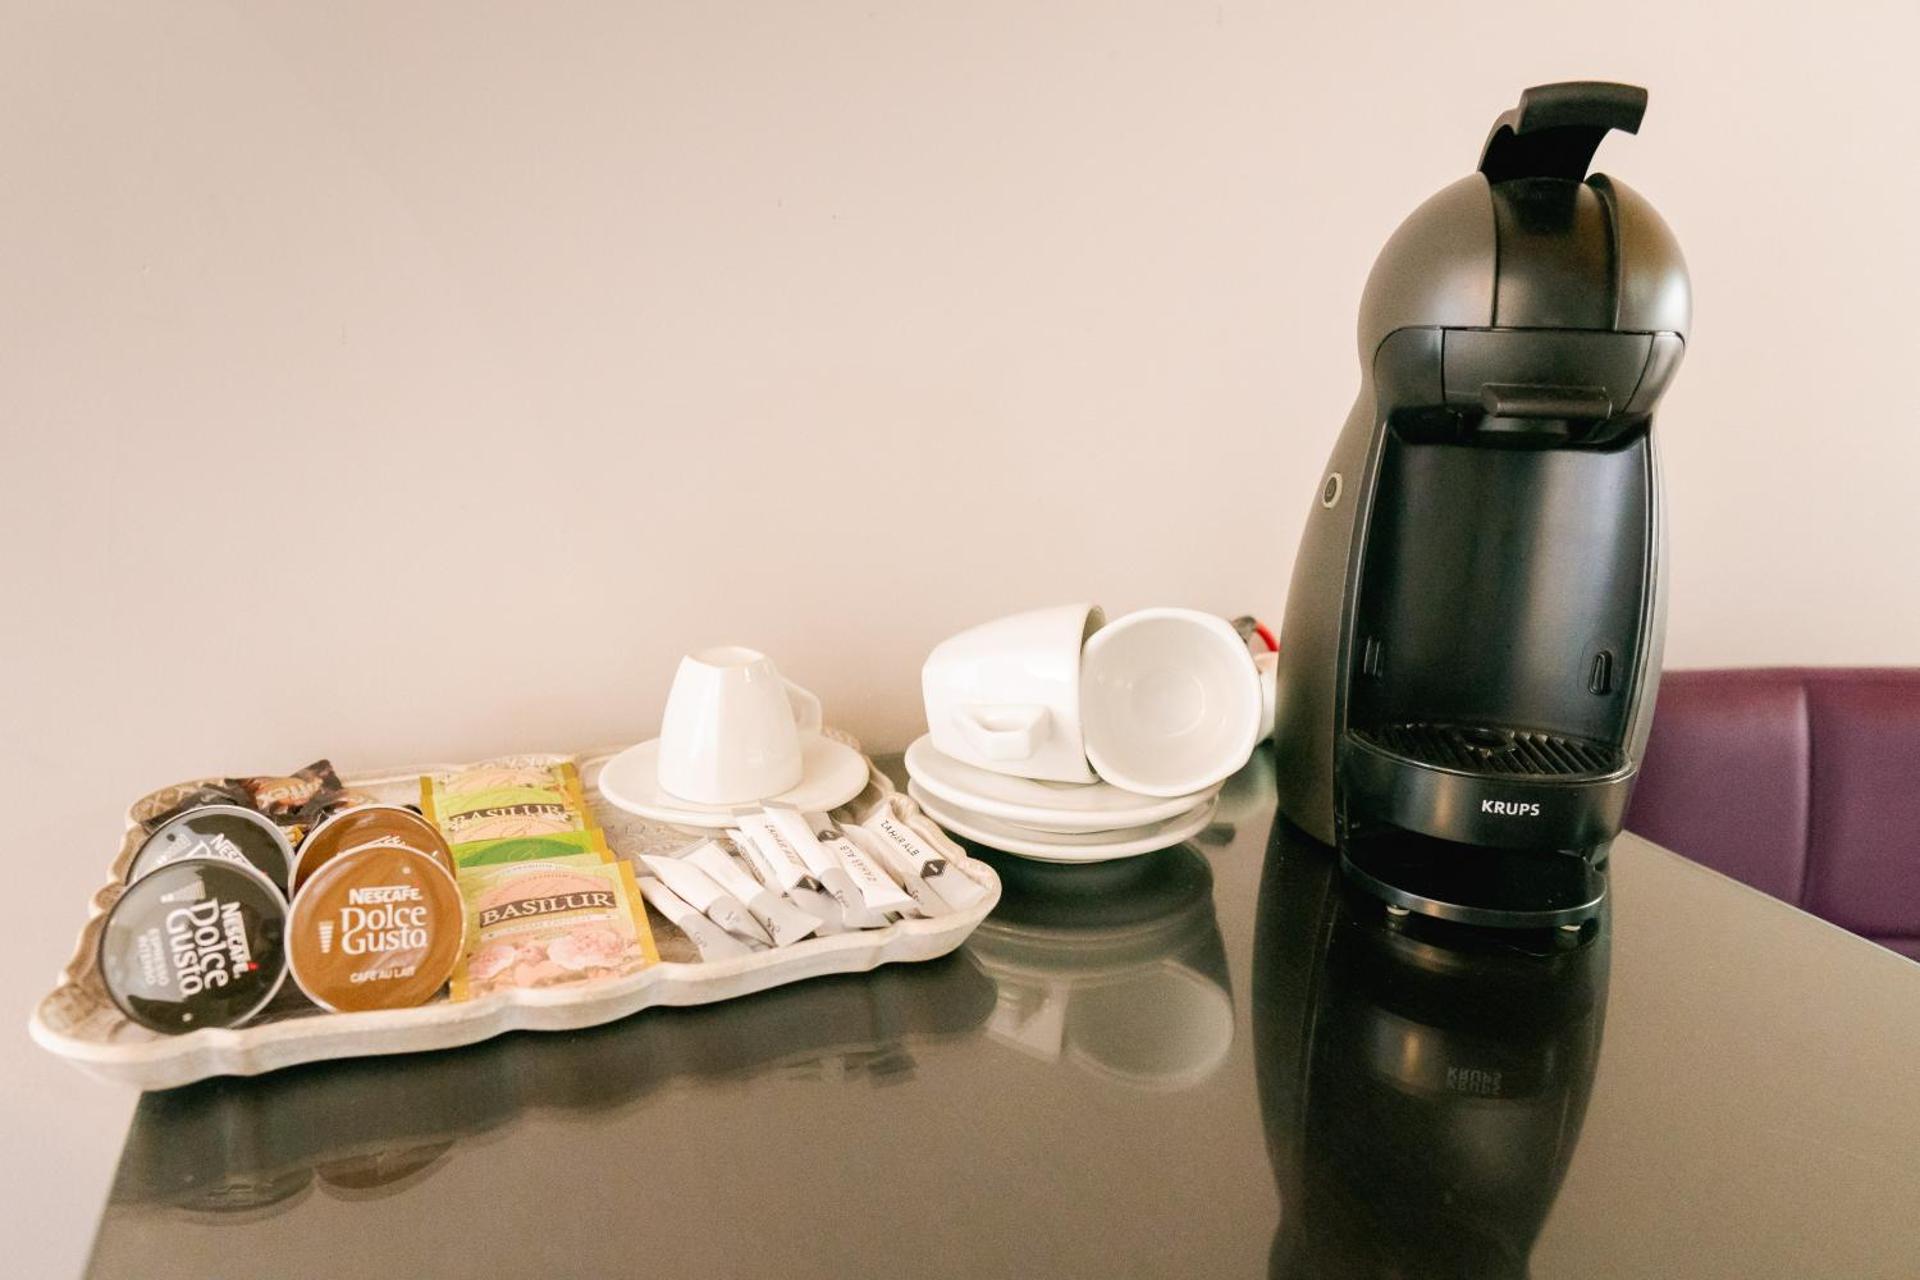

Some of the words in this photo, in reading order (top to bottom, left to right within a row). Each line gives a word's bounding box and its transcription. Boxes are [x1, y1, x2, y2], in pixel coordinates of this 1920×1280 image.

[449, 804, 568, 831] BASILUR
[1481, 799, 1540, 816] KRUPS
[340, 903, 428, 932] Dolce
[482, 892, 614, 927] BASILUR
[166, 908, 204, 997] Gusto
[190, 897, 229, 990] Dolce
[341, 923, 429, 955] Gusto
